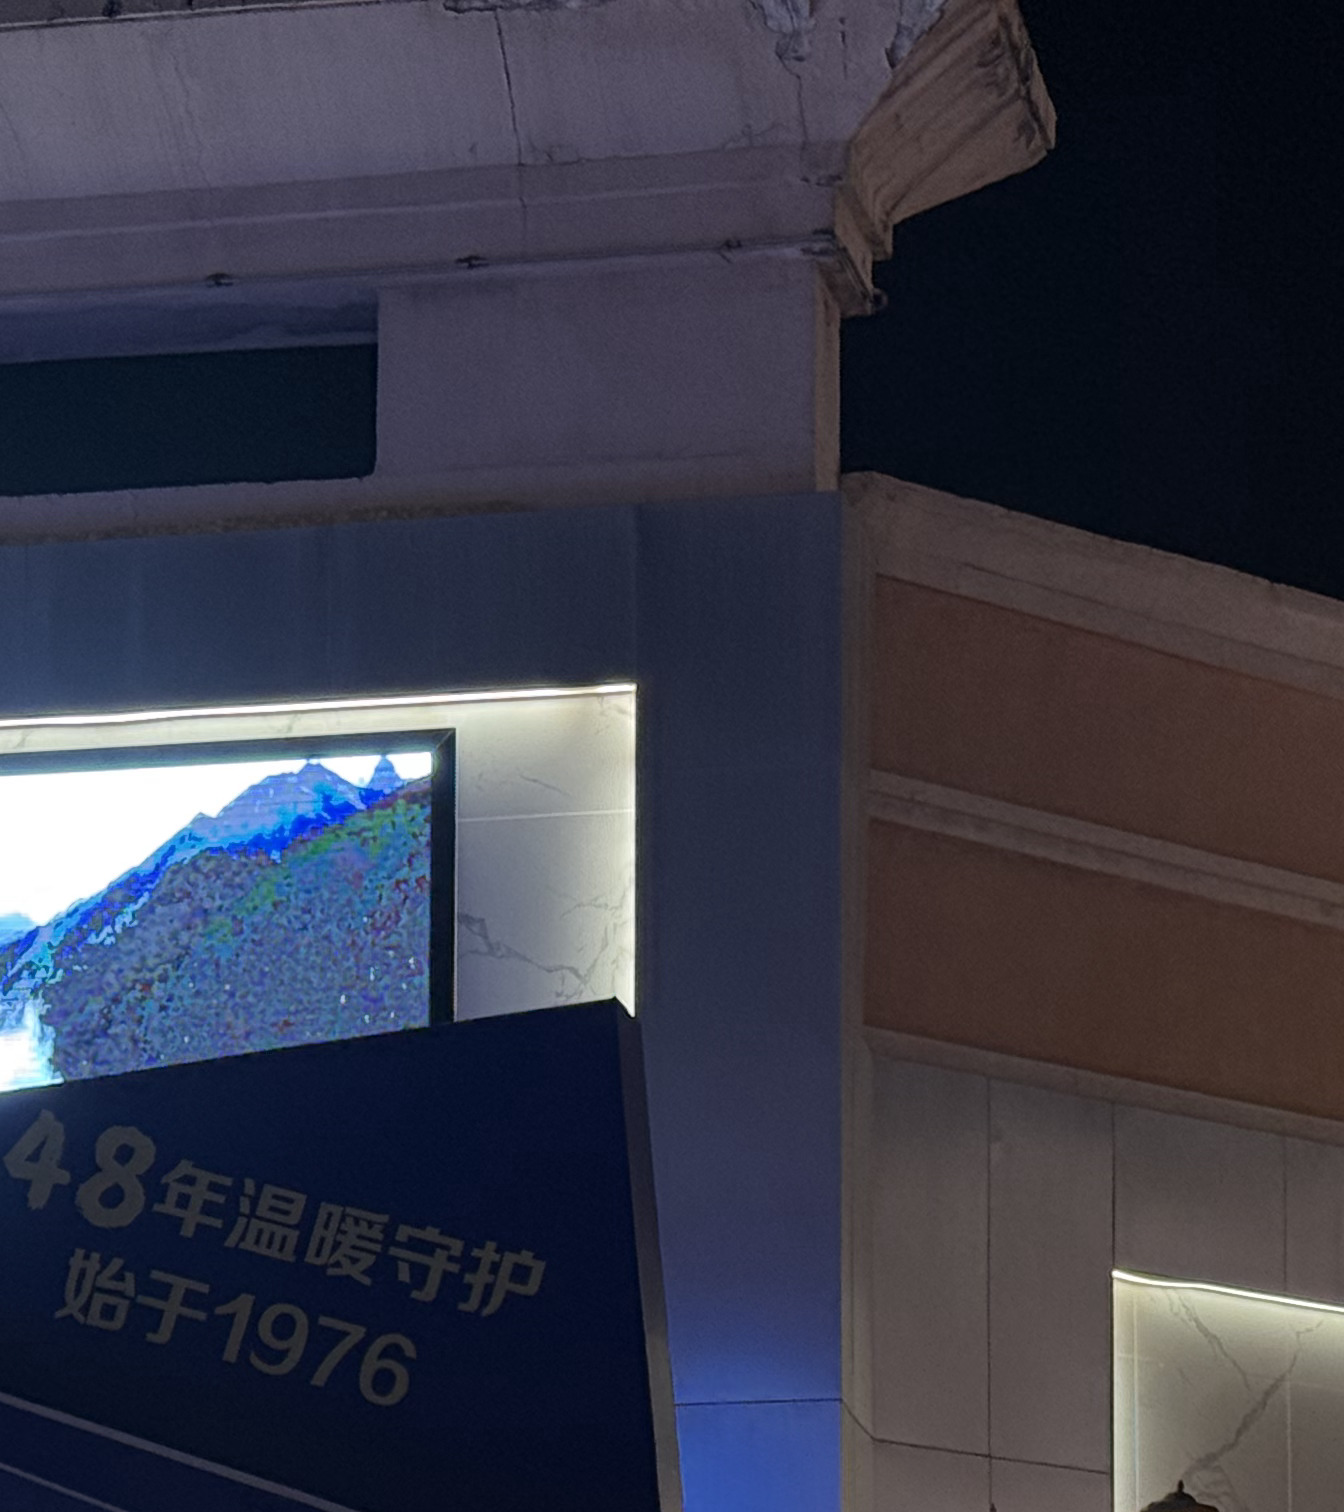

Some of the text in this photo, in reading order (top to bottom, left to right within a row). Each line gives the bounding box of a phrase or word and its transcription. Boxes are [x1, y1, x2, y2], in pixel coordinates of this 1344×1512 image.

[3, 1108, 547, 1318] 48年温暖守护
[54, 1248, 418, 1407] 始于1976
